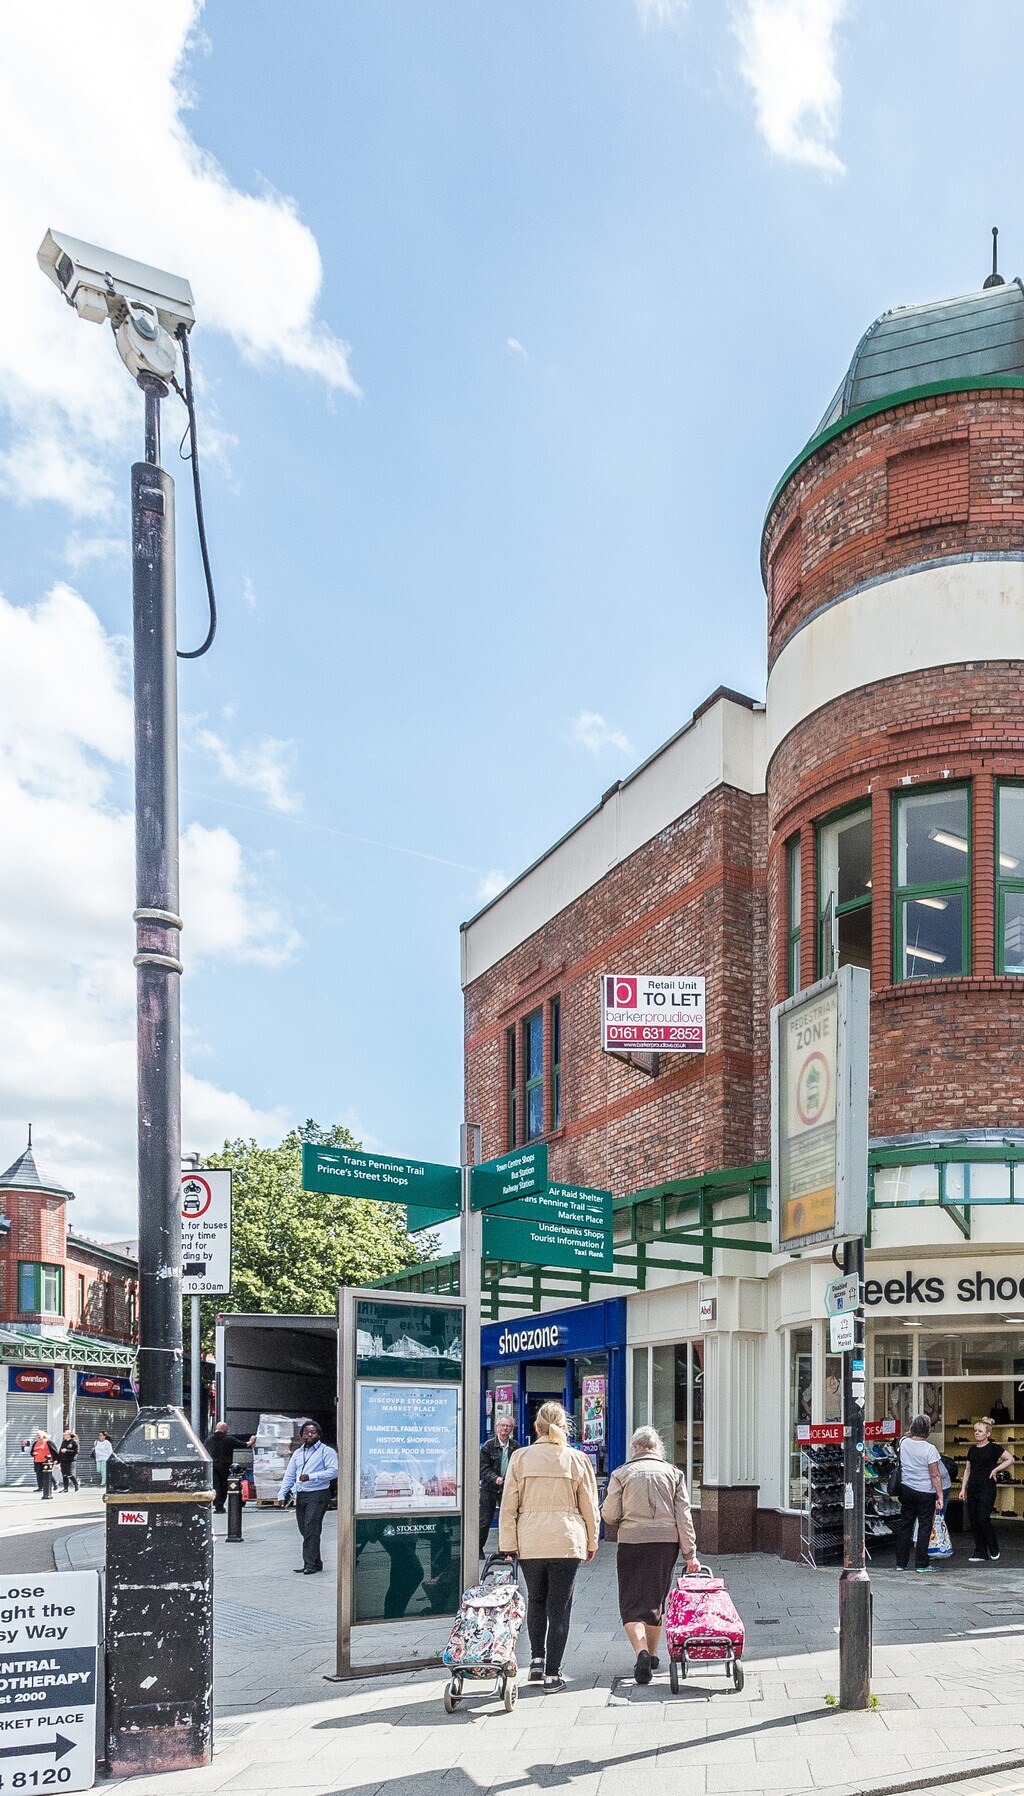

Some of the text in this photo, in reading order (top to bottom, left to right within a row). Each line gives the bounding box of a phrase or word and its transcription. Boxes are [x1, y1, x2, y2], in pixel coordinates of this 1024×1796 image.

[648, 981, 697, 989] Retail Unit
[643, 993, 702, 1006] TO LET
[606, 1010, 703, 1024] barkerproudlove
[609, 1026, 700, 1040] 0161 631 2852
[797, 1017, 829, 1050] ZONE
[342, 1156, 425, 1176] Trans Pennine Trail
[496, 1154, 535, 1173] Town Centre Shops
[317, 1164, 409, 1186] Prince's Street Shops
[519, 1167, 535, 1177] Station
[502, 1179, 535, 1194] Railway Station
[549, 1188, 603, 1203] Air Raid Shelter
[538, 1196, 569, 1208] Pennine
[570, 1201, 586, 1210] Trail
[558, 1211, 604, 1224] Market Place
[198, 1231, 216, 1239] time
[538, 1223, 605, 1239] Underbanks Shops
[530, 1233, 556, 1243] Tourist
[557, 1236, 600, 1249] Information
[183, 1252, 213, 1260] ding by
[588, 1250, 604, 1258] Rank
[831, 1281, 848, 1292] Disabled
[864, 1270, 945, 1306] eeks
[498, 1325, 559, 1355] shoezone
[20, 1375, 48, 1383] swinton
[396, 1524, 437, 1532] STOCKPORT
[1, 1604, 75, 1622] ght the
[0, 1625, 68, 1643] sy Way
[0, 1672, 91, 1690] OTHERAPY
[0, 1691, 47, 1704] st 2000
[37, 1713, 84, 1727] PLACE
[12, 1767, 71, 1788] 8120
